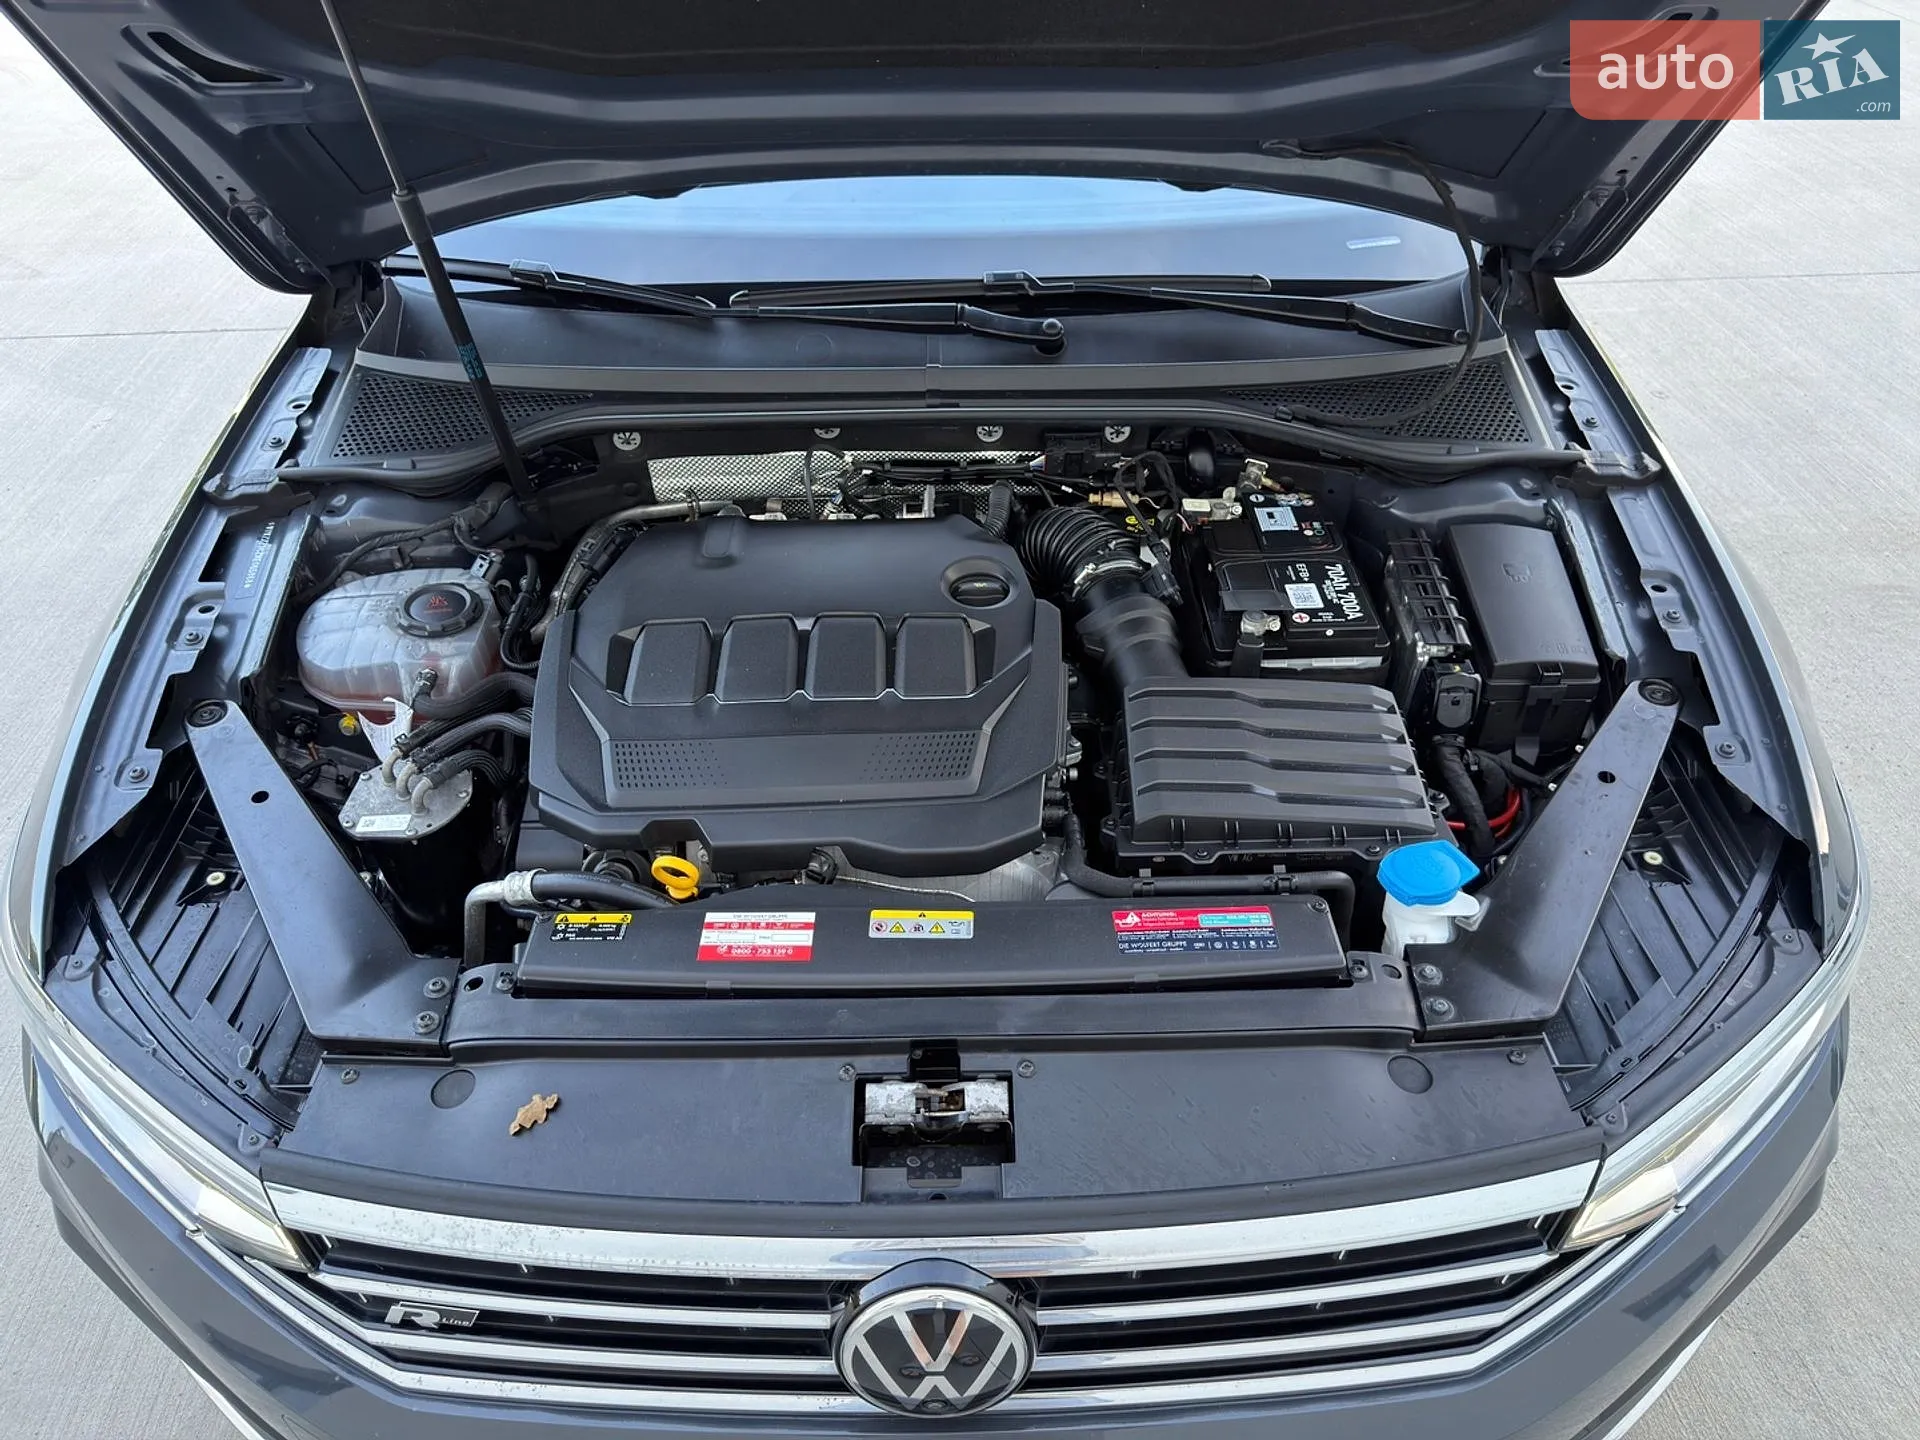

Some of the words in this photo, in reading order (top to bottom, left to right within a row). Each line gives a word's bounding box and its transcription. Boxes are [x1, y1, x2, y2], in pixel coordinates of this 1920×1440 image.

[1325, 564, 1350, 590] 70Ah
[1337, 592, 1364, 620] 700A
[384, 1305, 440, 1329] R
[846, 1298, 1021, 1412] VW
